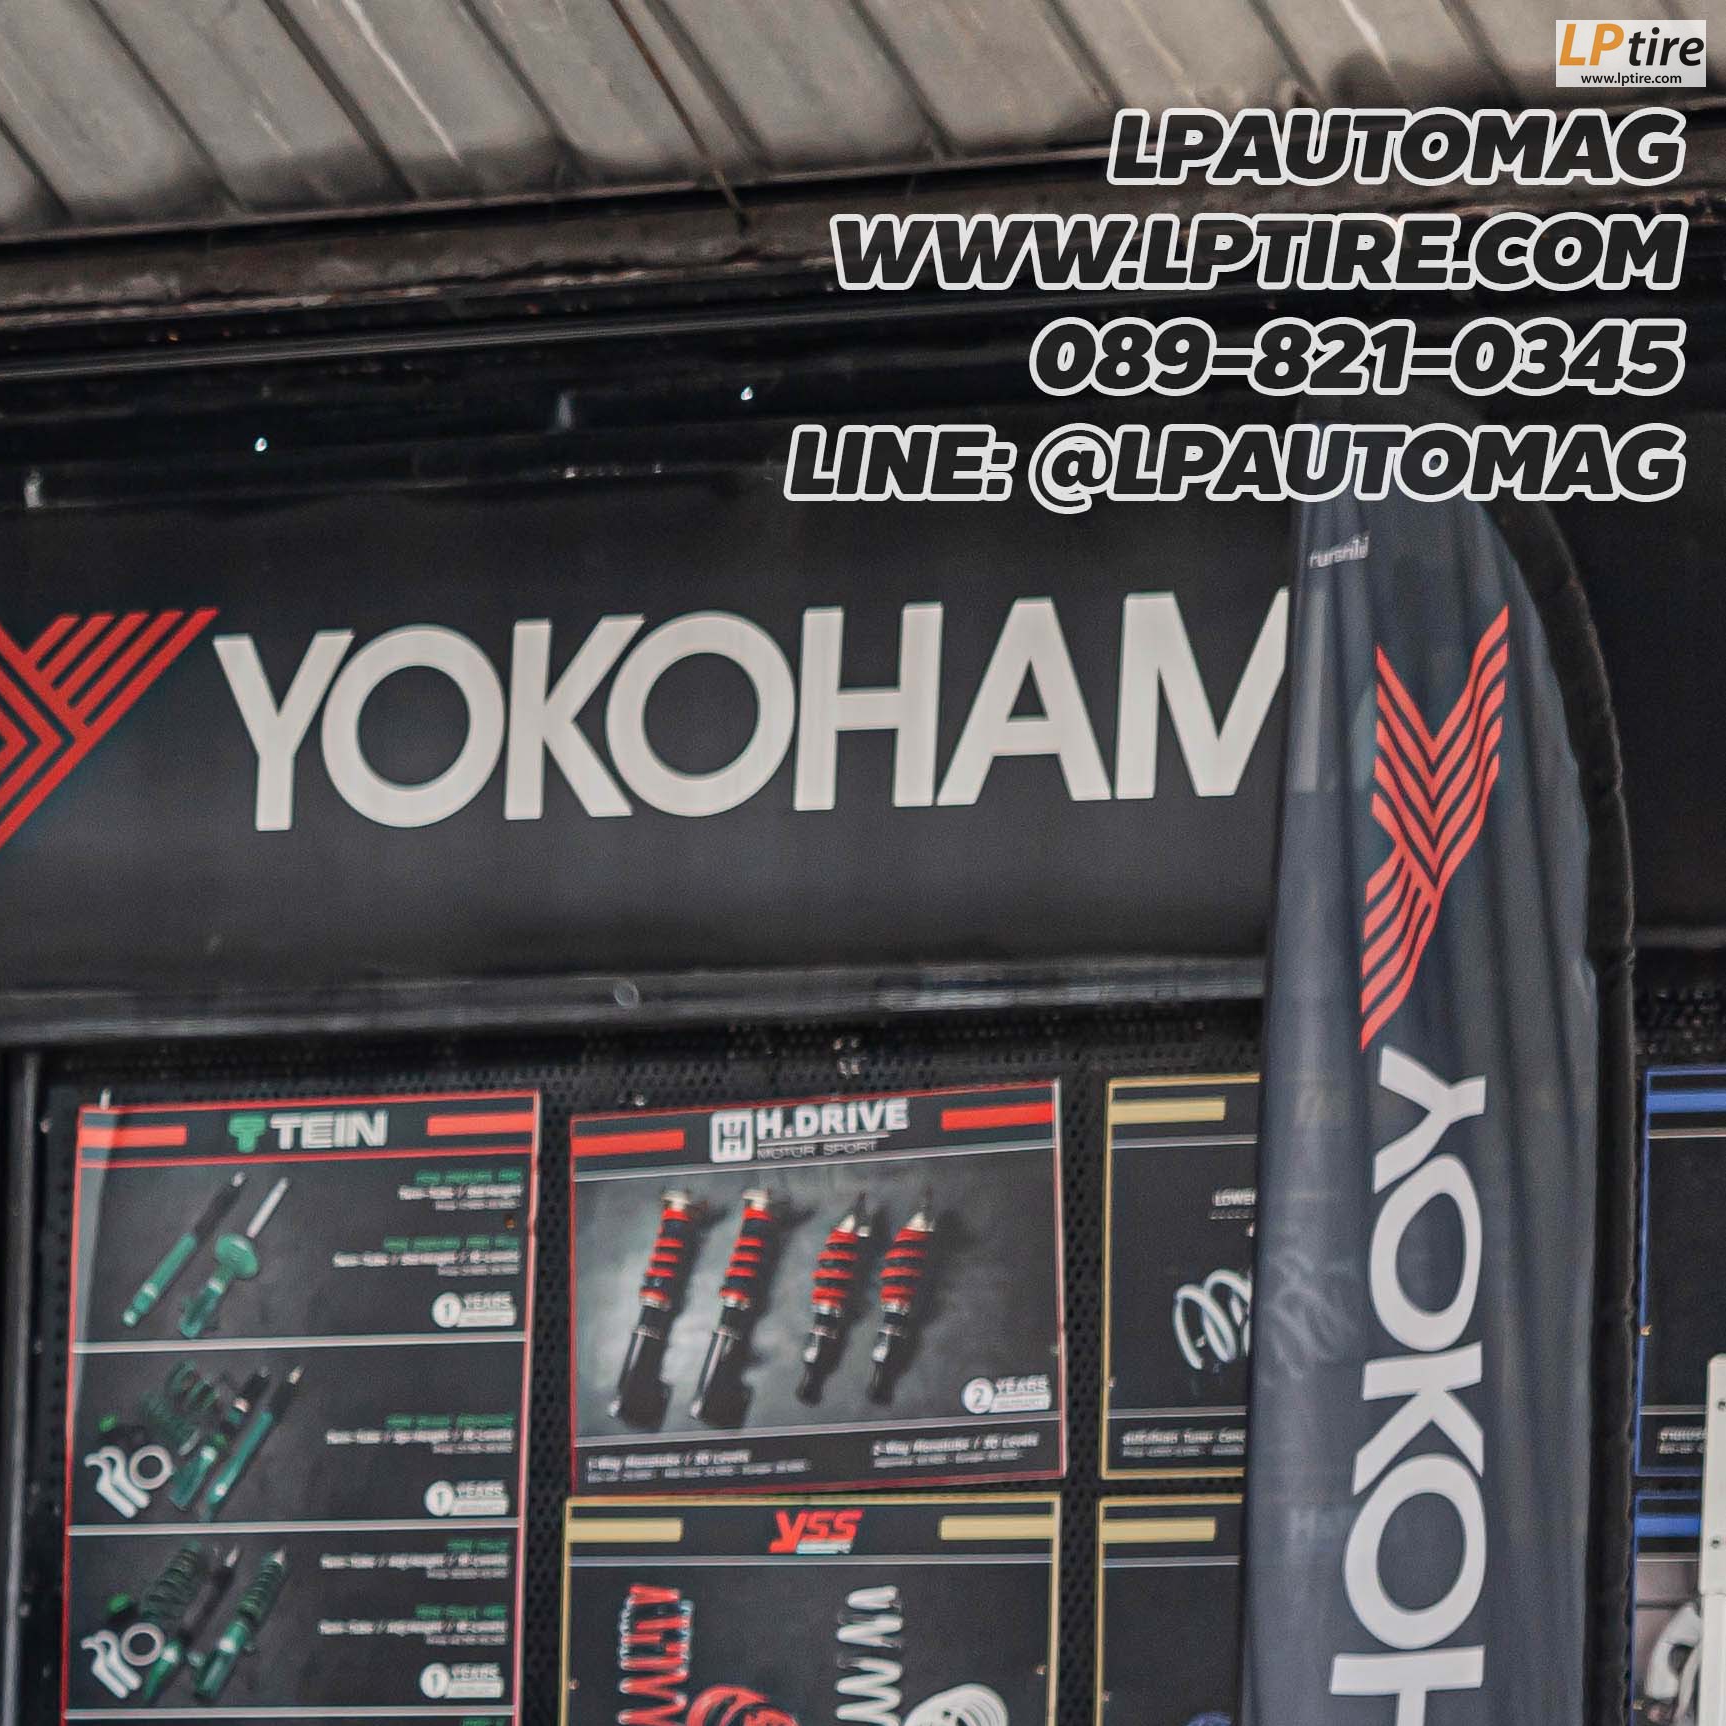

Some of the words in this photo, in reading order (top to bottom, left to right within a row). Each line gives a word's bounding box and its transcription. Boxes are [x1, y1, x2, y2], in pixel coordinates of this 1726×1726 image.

[213, 586, 1290, 831] YOKOHAM
[270, 1109, 390, 1150] TEIN
[756, 1098, 909, 1140] H.DRIVE
